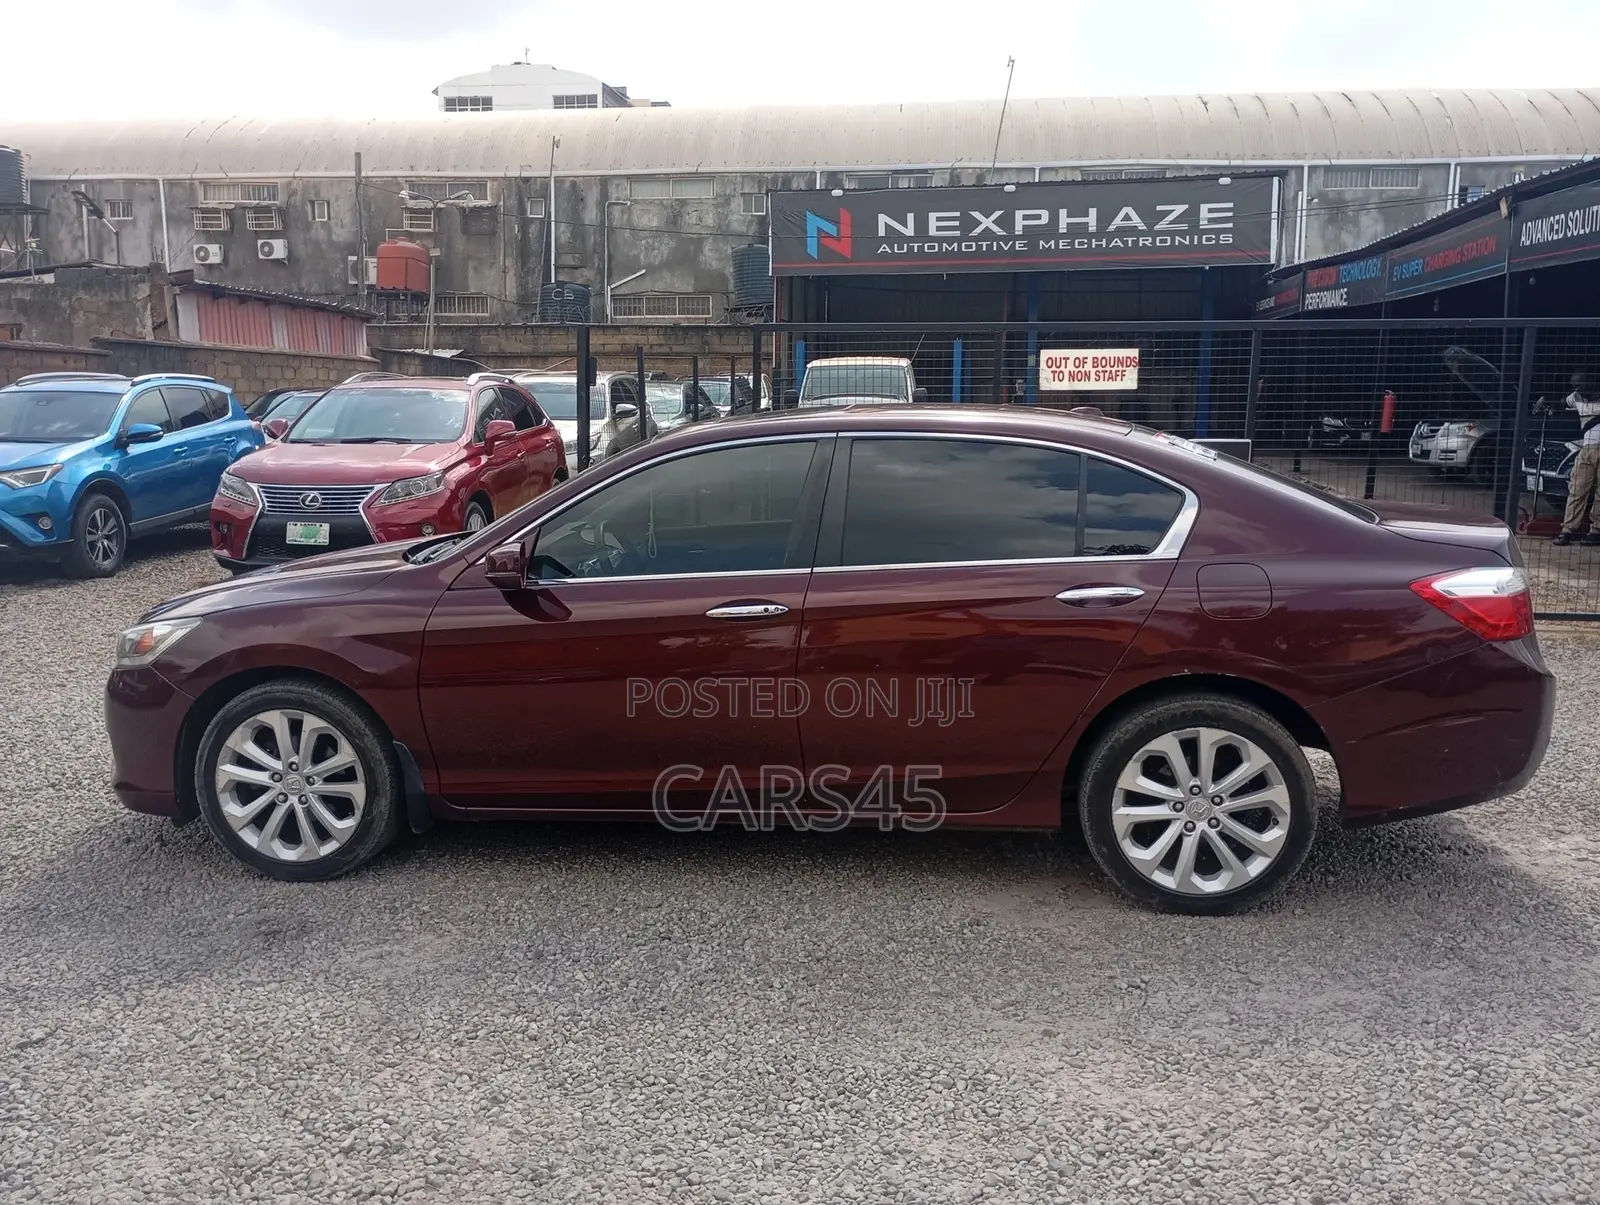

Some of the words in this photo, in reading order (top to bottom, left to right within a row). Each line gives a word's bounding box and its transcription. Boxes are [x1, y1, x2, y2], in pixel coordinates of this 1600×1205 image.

[877, 202, 1234, 237] NEXPHAZE
[1520, 213, 1566, 247] ADVANCED
[877, 240, 1028, 254] AUTOMOTIVE
[1039, 233, 1233, 250] MECHATRONICS
[1402, 258, 1423, 279] SUPER
[1424, 246, 1461, 272] CHARGING
[1462, 235, 1496, 262] STATION
[1045, 357, 1070, 369] OUT
[1073, 357, 1088, 368] OF
[1092, 356, 1138, 368] BOUNDS
[1051, 371, 1065, 382] TO
[1068, 371, 1091, 382] NON
[1094, 370, 1127, 382] STAFF
